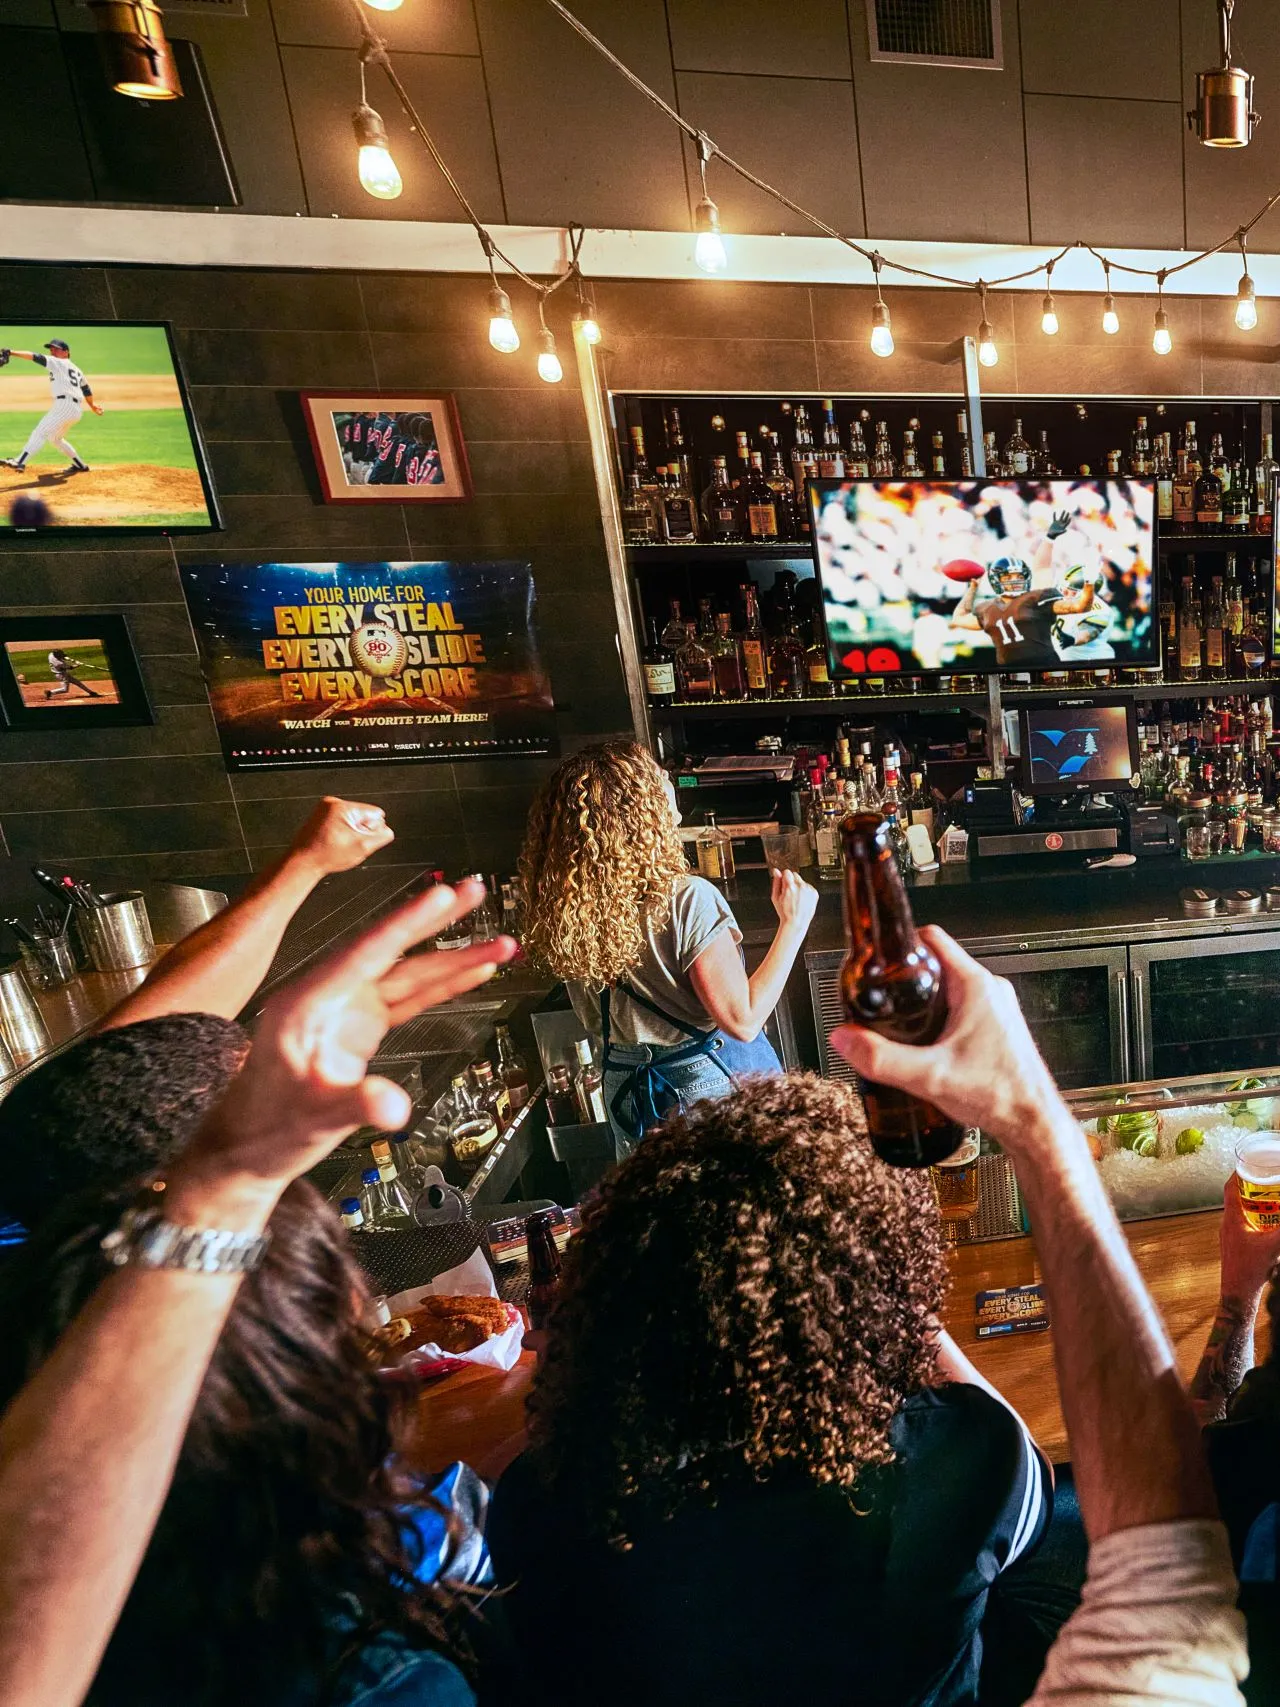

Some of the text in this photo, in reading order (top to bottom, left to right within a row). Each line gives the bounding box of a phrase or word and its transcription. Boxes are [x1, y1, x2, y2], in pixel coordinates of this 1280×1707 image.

[304, 585, 425, 604] YOUR HOME FOR
[273, 602, 464, 635] EVERY STEAL
[996, 616, 1024, 645] 11
[262, 634, 487, 670] EVERY SLIDE
[369, 642, 387, 652] 90
[280, 667, 479, 701] EVERY SCORE
[284, 719, 331, 729] WATCH
[353, 716, 414, 727] FAVORITE
[416, 714, 451, 725] TEAM
[453, 713, 489, 723] HERE!
[984, 1294, 1040, 1308] EVERY STEAL
[979, 1306, 1006, 1316] EVERY
[982, 1312, 1010, 1321] EVERY
